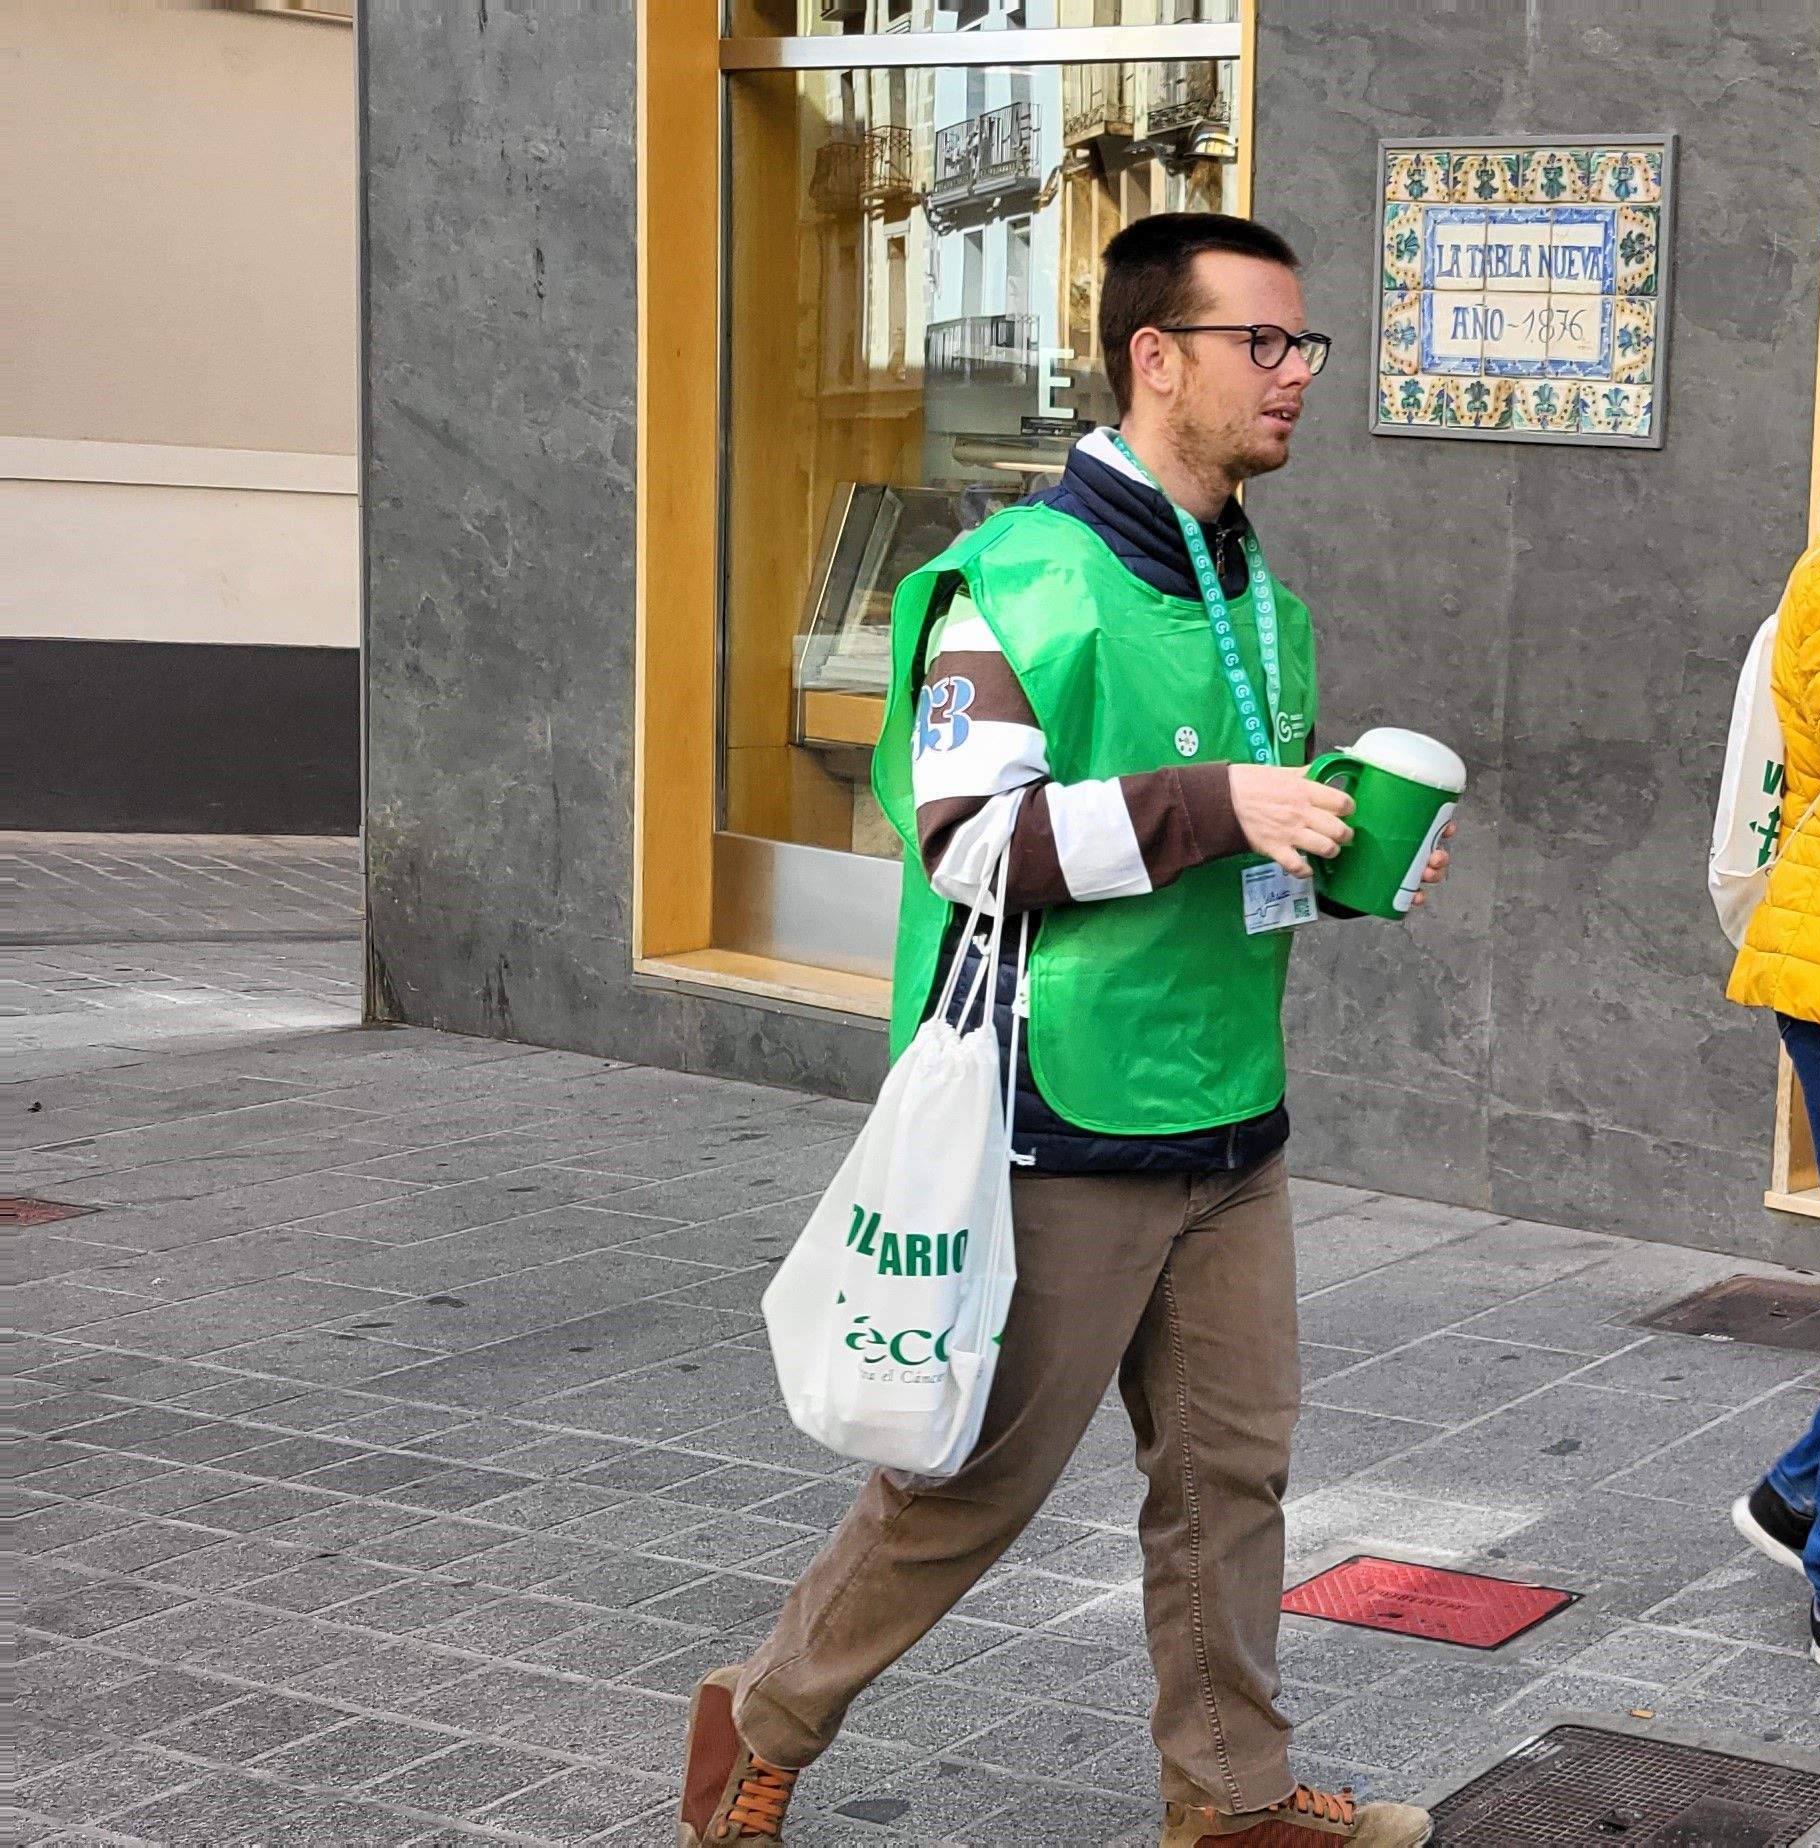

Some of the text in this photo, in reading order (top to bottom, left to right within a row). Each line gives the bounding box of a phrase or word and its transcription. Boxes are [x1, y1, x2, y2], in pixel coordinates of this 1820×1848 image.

[1436, 244, 1603, 281] LA TABLA NUEVA
